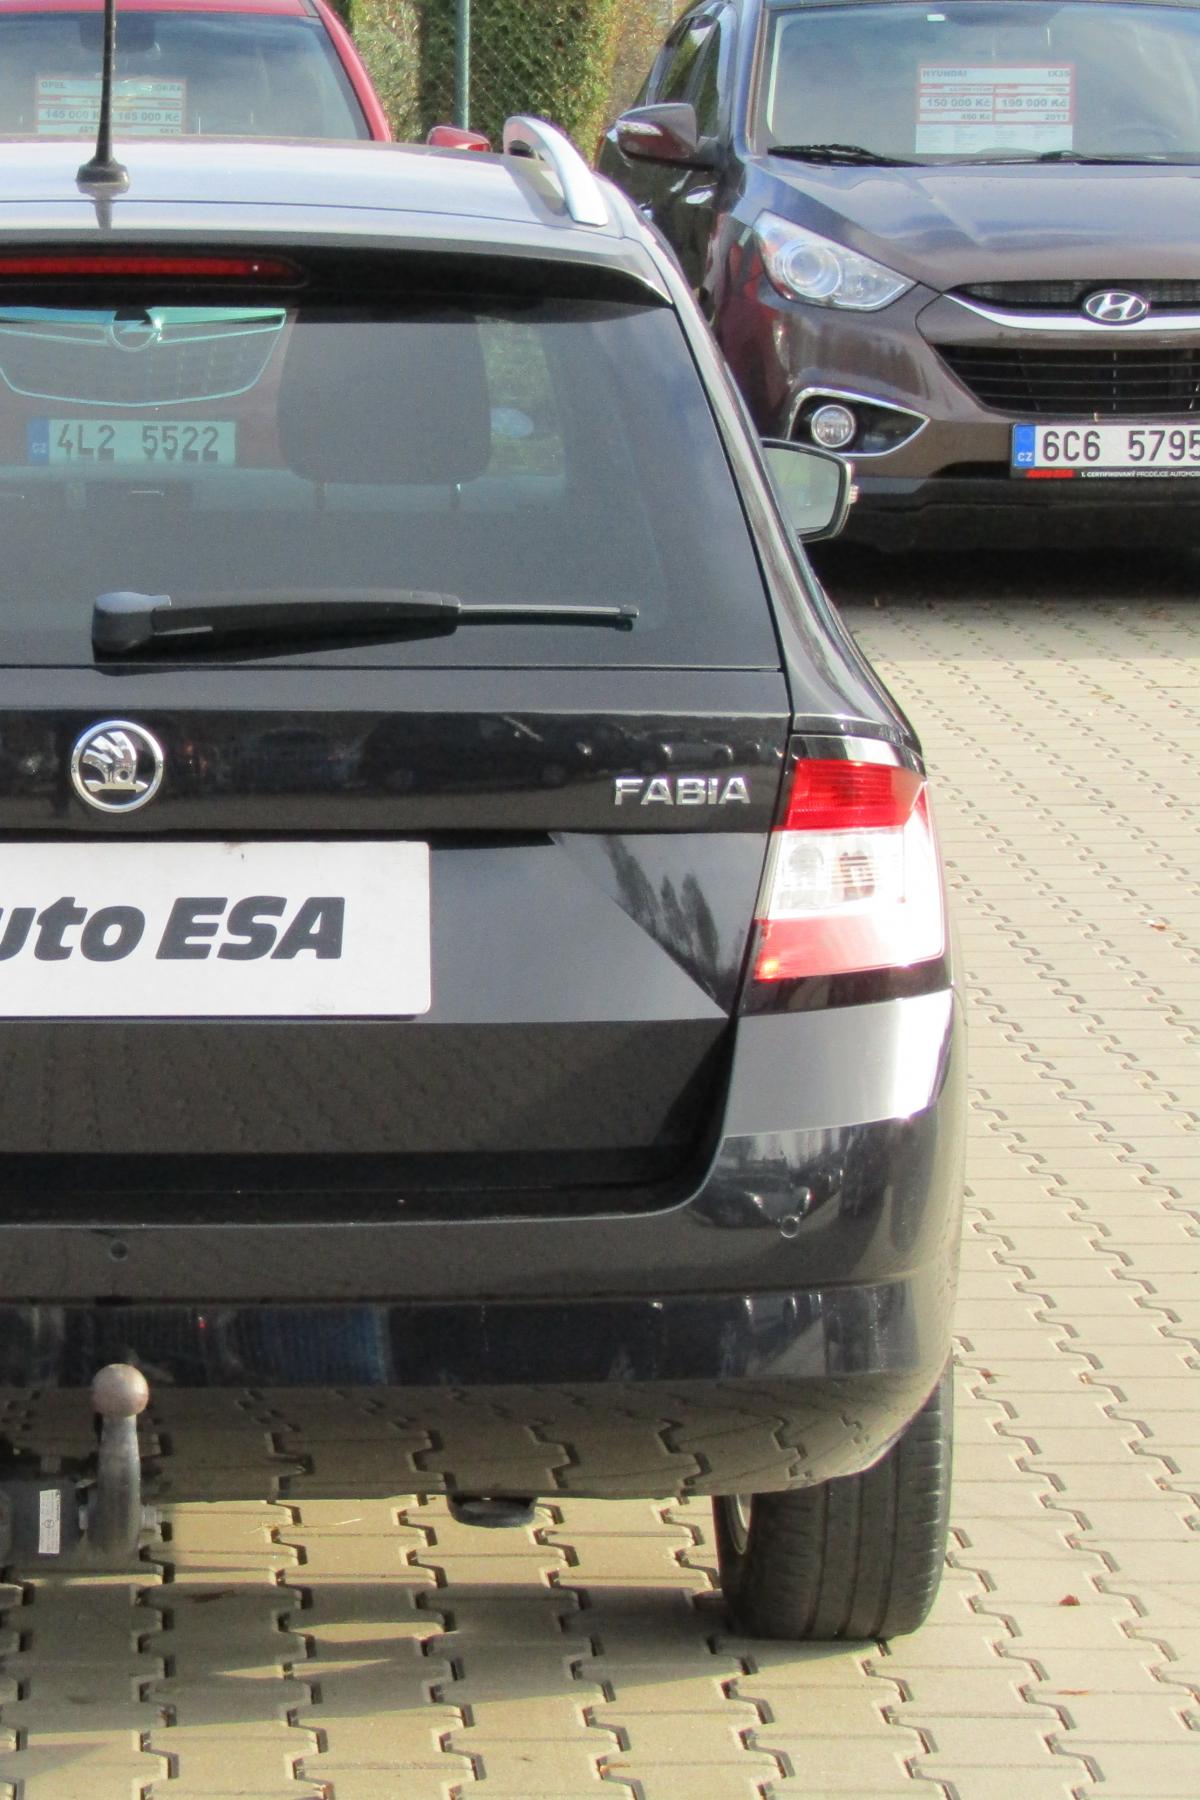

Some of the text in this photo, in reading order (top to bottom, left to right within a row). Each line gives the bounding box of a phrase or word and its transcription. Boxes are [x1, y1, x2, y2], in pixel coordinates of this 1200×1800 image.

[926, 98, 948, 107] 150
[950, 98, 972, 107] 000
[1025, 98, 1048, 107] 000
[68, 110, 89, 119] 000
[140, 111, 161, 121] 000
[56, 423, 219, 463] 4L2 5522
[1042, 430, 1200, 462] 6C6 5795
[1017, 451, 1033, 463] CZ
[613, 776, 751, 806] FABIA
[155, 896, 346, 961] ESA
